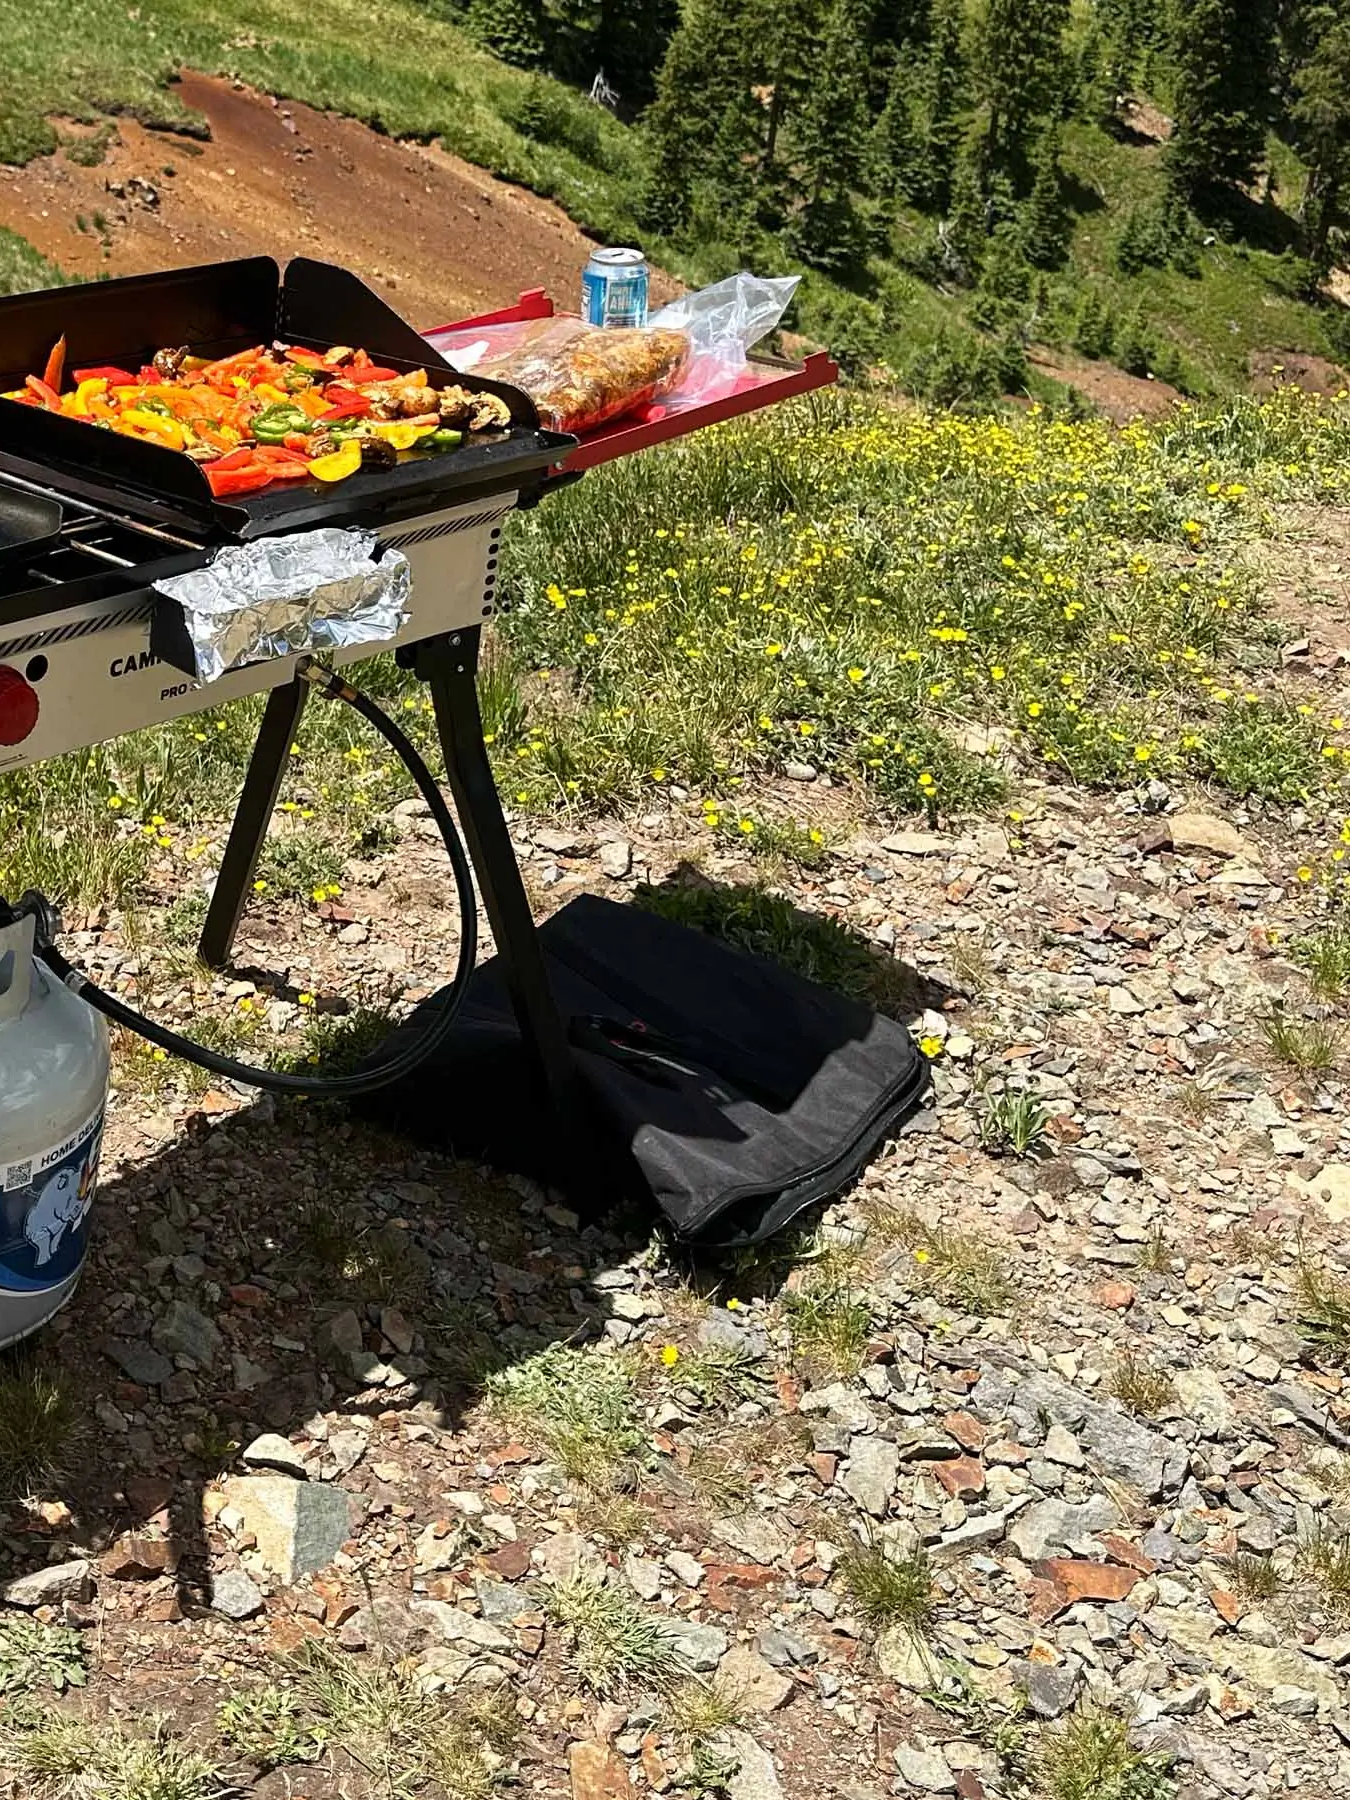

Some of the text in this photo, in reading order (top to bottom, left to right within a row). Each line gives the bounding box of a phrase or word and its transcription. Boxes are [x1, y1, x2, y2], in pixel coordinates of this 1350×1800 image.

[110, 652, 161, 677] CAM
[160, 683, 187, 700] PRO
[41, 1138, 76, 1167] HOME
